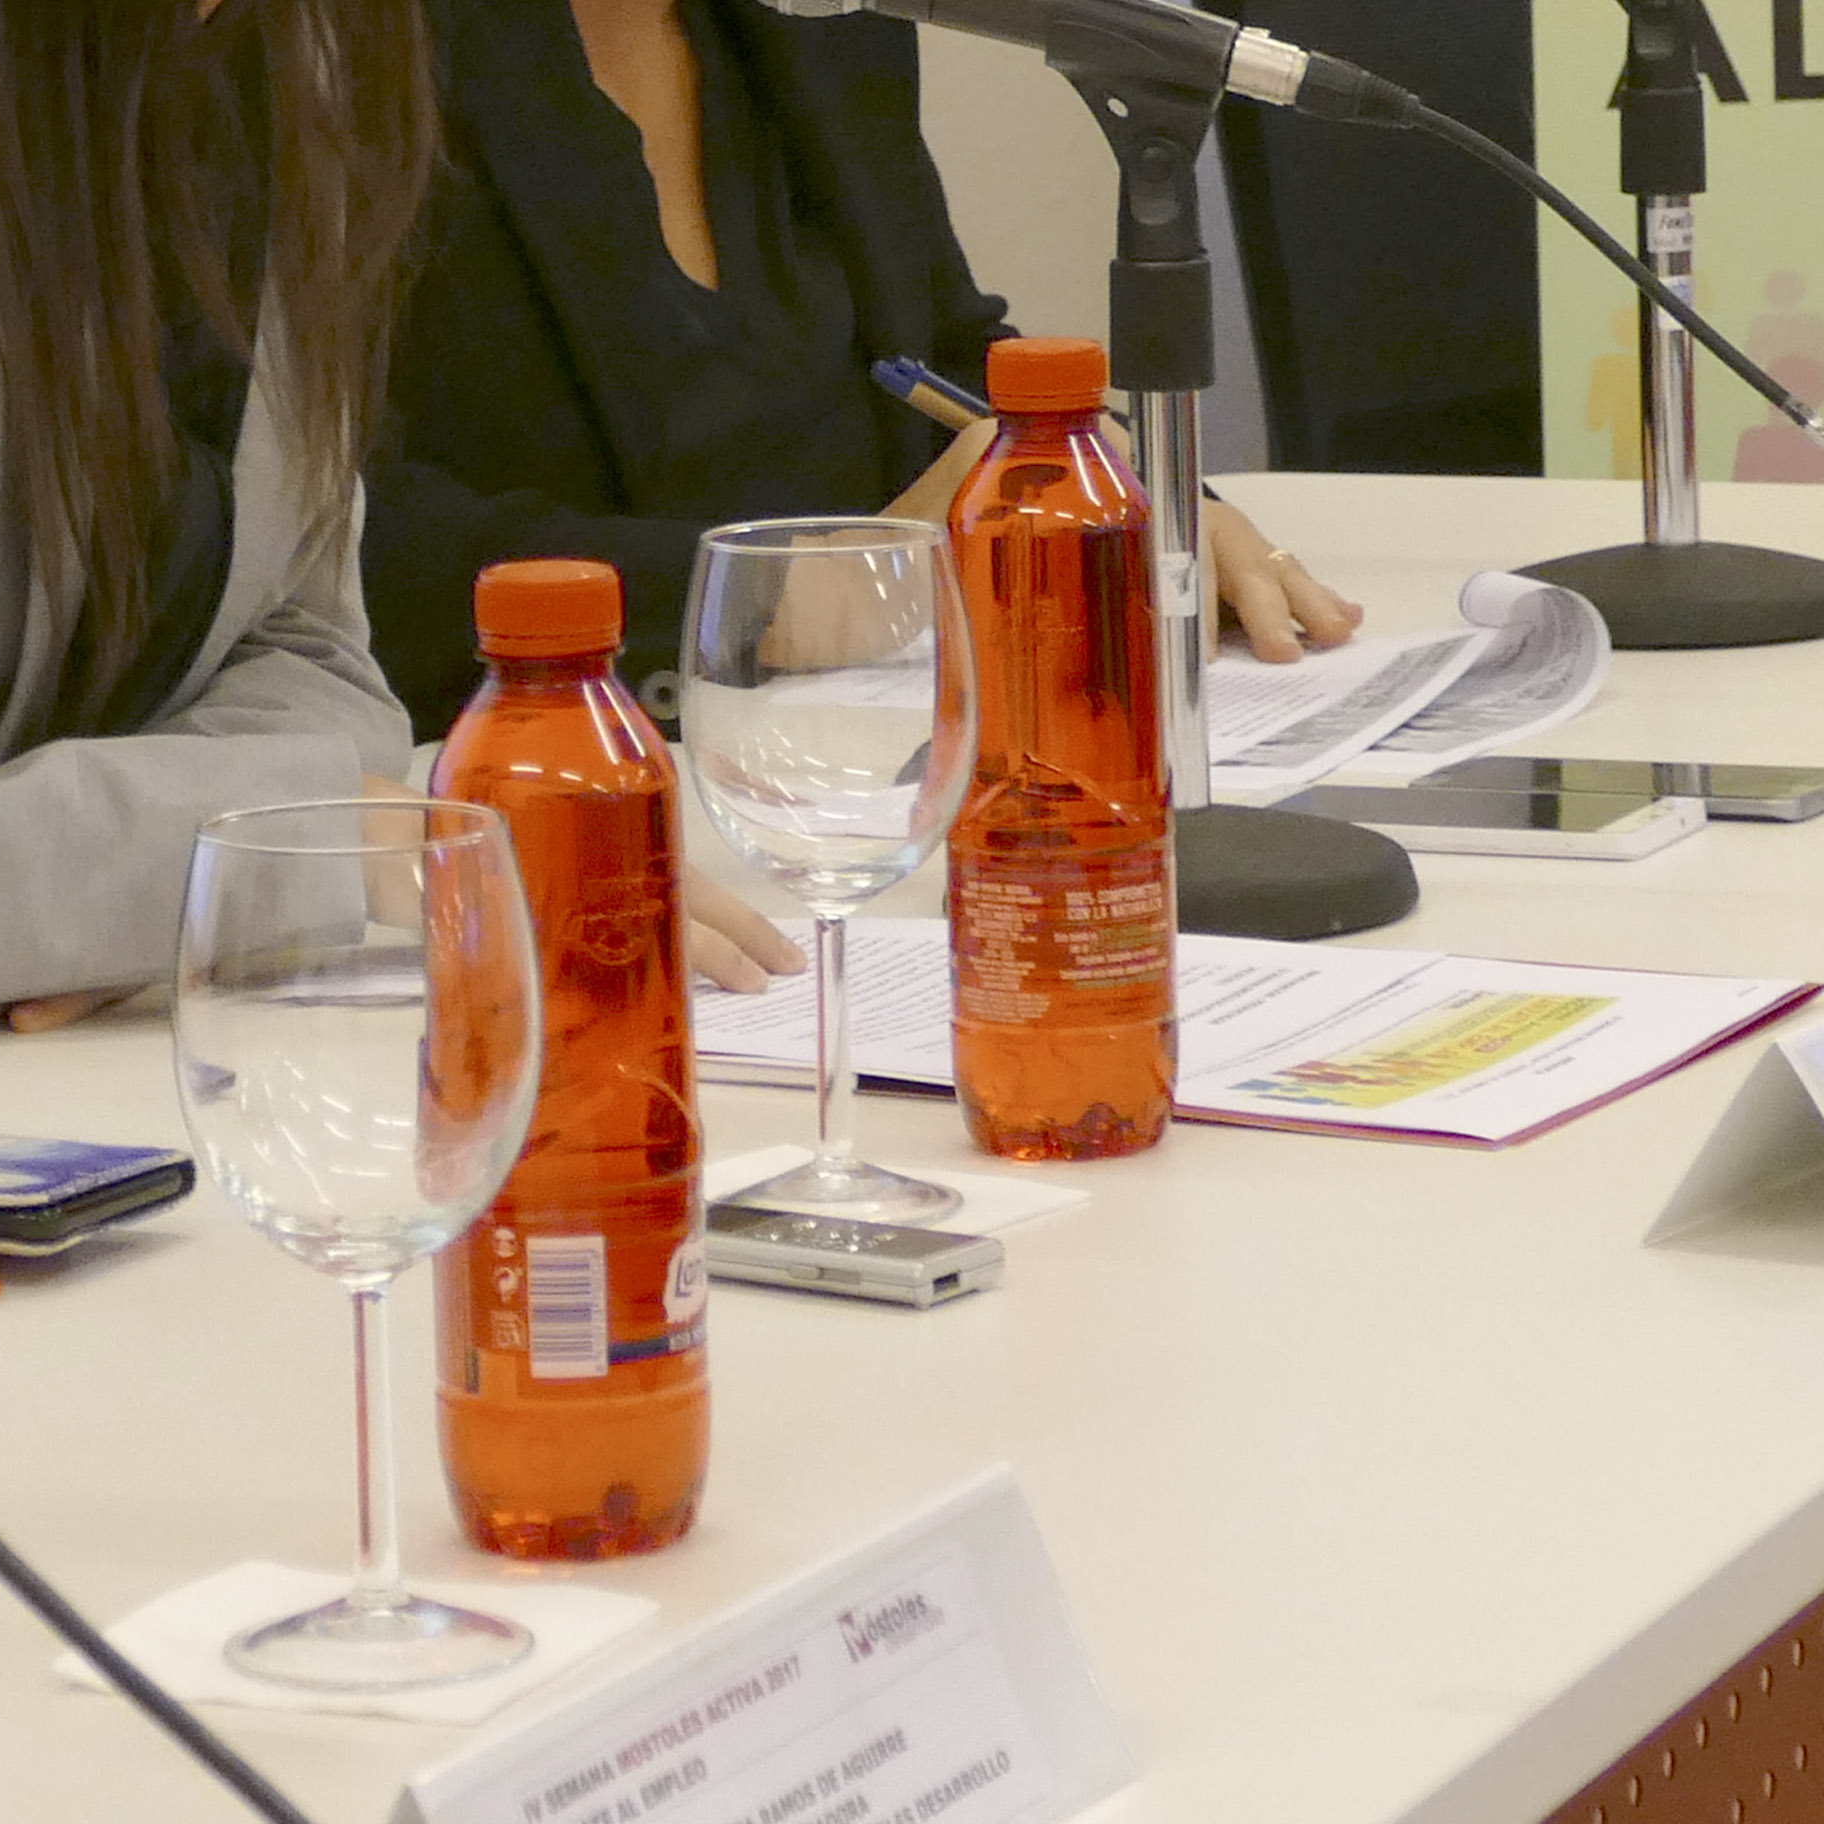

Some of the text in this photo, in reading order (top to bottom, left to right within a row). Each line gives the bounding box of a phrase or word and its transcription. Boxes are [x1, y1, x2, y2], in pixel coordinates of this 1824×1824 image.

[544, 1759, 615, 1814] SEMANA
[705, 1676, 765, 1725] ACTIVA
[763, 1654, 801, 1694] 2017
[758, 1728, 907, 1824] RAMOS DE AGUIRRE
[639, 1756, 707, 1810] EMPLEO
[914, 1750, 1010, 1824] DESARROLLO
